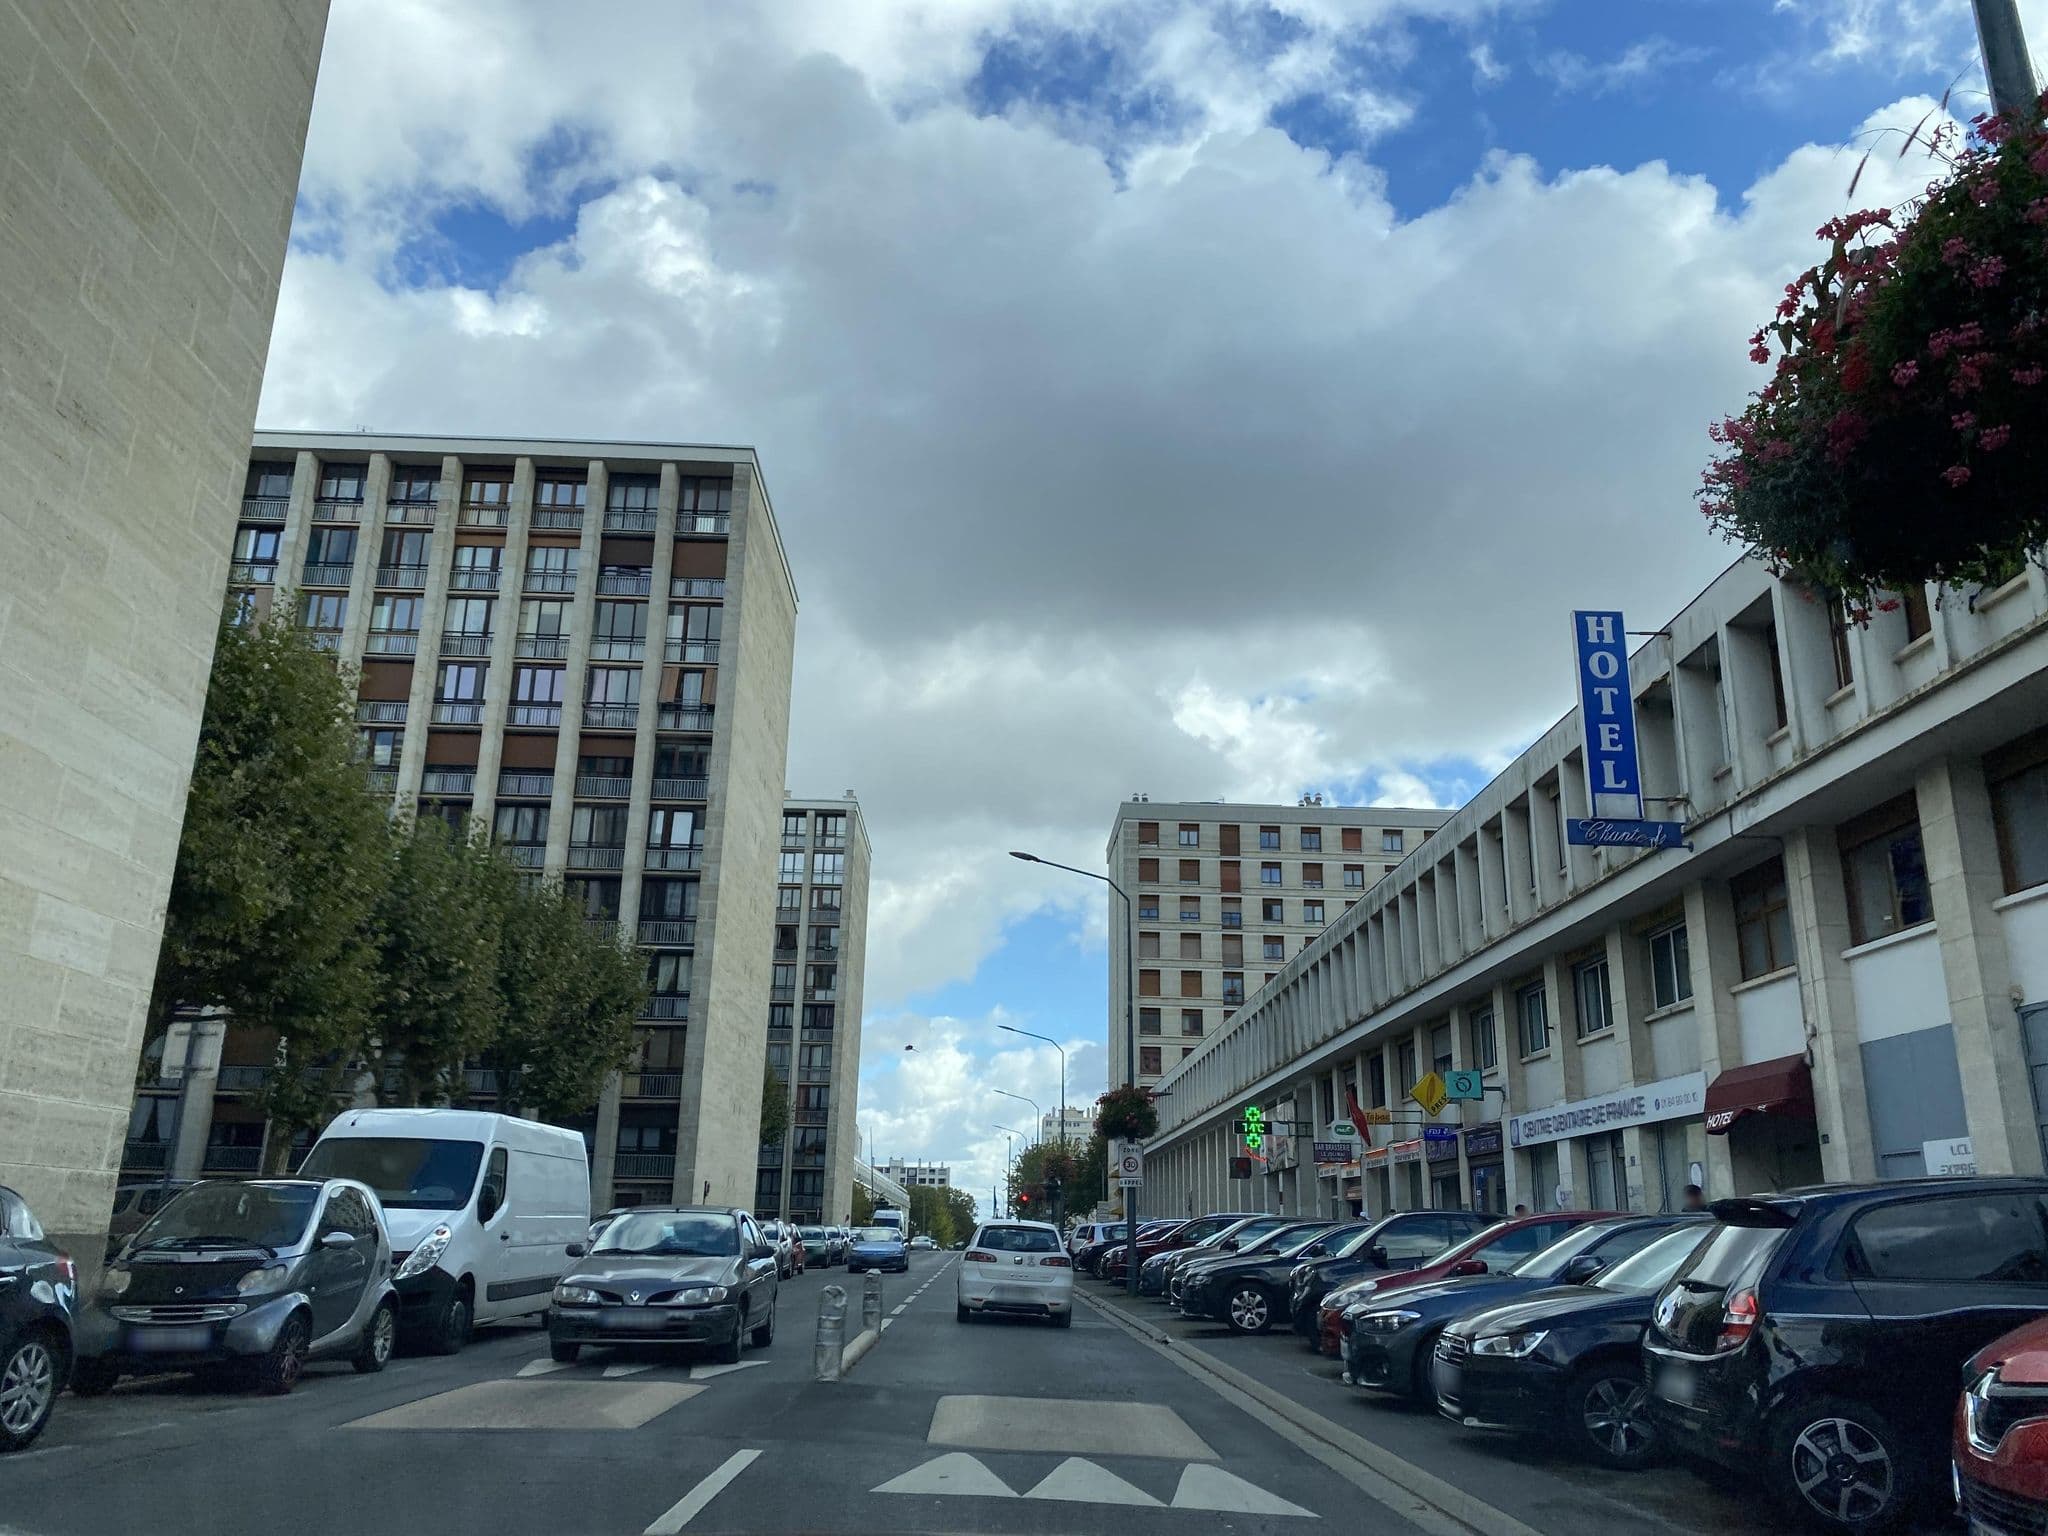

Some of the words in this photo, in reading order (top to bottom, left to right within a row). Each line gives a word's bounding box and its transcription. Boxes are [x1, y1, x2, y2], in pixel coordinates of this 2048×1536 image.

[1585, 615, 1628, 790] HOTEL
[1365, 1111, 1390, 1122] Tabac
[1522, 1116, 1552, 1138] CENTRE
[1552, 1108, 1592, 1132] DENTAIRE
[1592, 1105, 1606, 1124] DE
[1605, 1095, 1646, 1121] FRANCE
[1705, 1111, 1735, 1129] HOTEL
[1427, 1127, 1441, 1135] FDJ
[1325, 1143, 1351, 1151] BRASSERIE
[1126, 1160, 1136, 1169] 30
